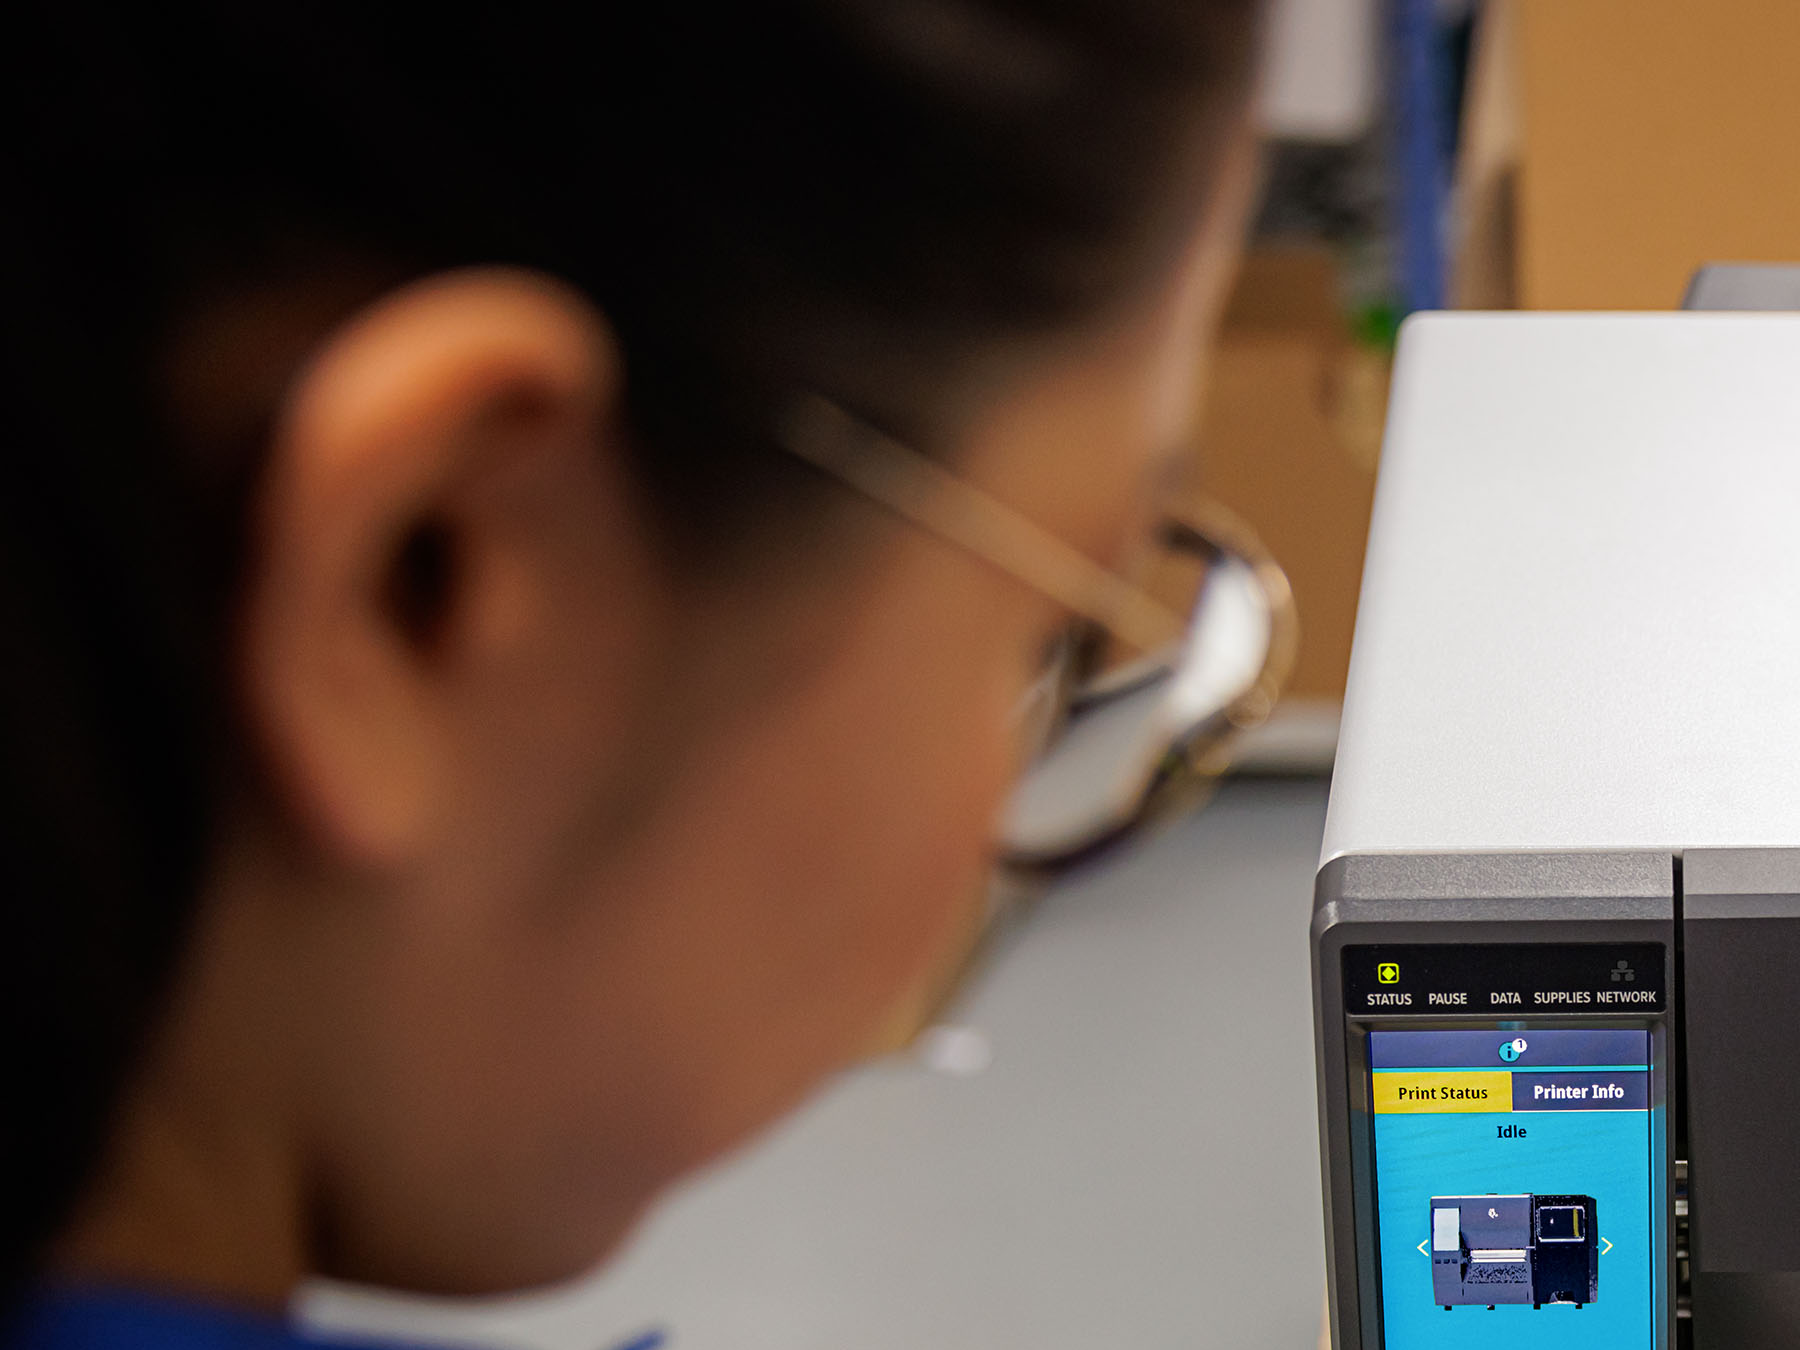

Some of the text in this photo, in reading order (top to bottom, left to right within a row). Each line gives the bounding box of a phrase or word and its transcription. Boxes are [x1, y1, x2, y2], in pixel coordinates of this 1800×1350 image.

[1368, 993, 1412, 1005] STATUS
[1429, 992, 1467, 1004] PAUSE
[1490, 992, 1521, 1004] DATA
[1534, 992, 1590, 1003] SUPPLIES
[1597, 991, 1656, 1003] NETWORK
[1399, 1086, 1488, 1100] Print Status
[1534, 1084, 1624, 1099] Printer Info
[1497, 1125, 1527, 1139] Idle
